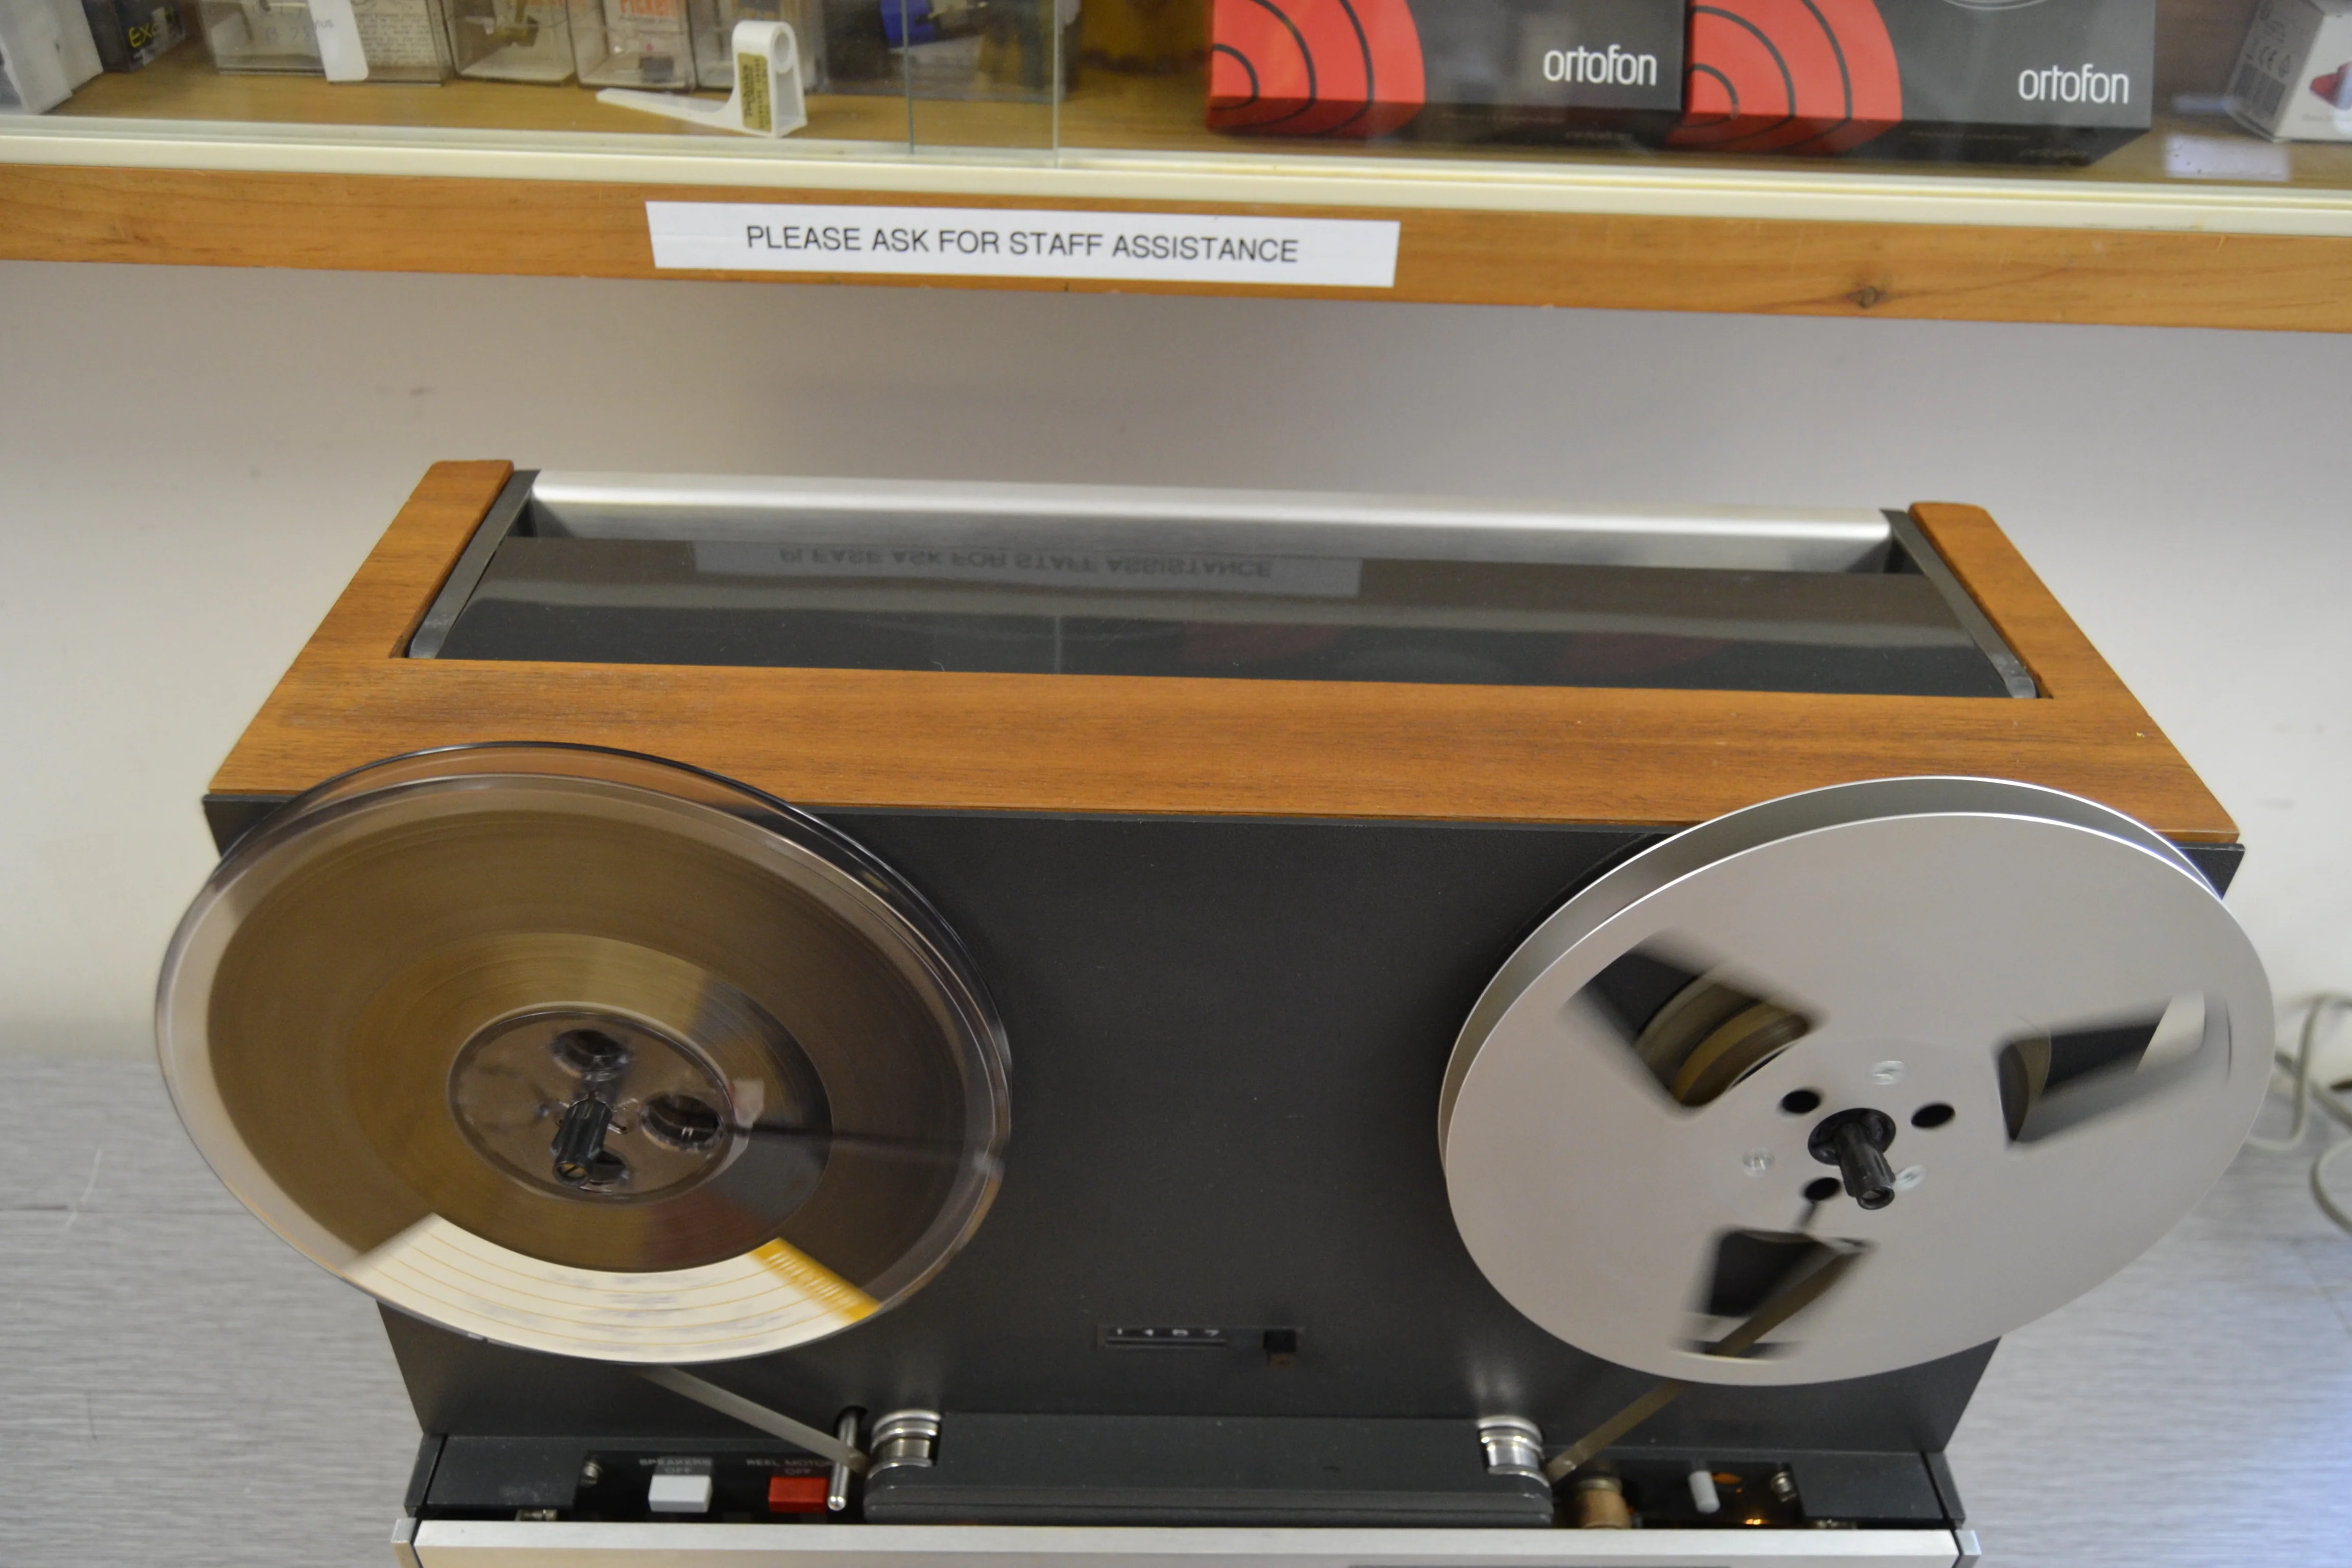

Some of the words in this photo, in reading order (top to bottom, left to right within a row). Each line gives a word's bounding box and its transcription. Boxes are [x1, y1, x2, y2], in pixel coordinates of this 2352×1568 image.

[1543, 44, 1657, 86] ortofon
[2018, 63, 2129, 104] ortofon
[747, 226, 861, 250] PLEASE
[872, 229, 928, 252] ASK
[939, 230, 999, 253] FOR
[1010, 232, 1103, 256] STAFF
[1113, 234, 1298, 263] ASSISTANCE
[639, 1458, 712, 1466] SPEAKERS
[746, 1458, 780, 1466] REEL
